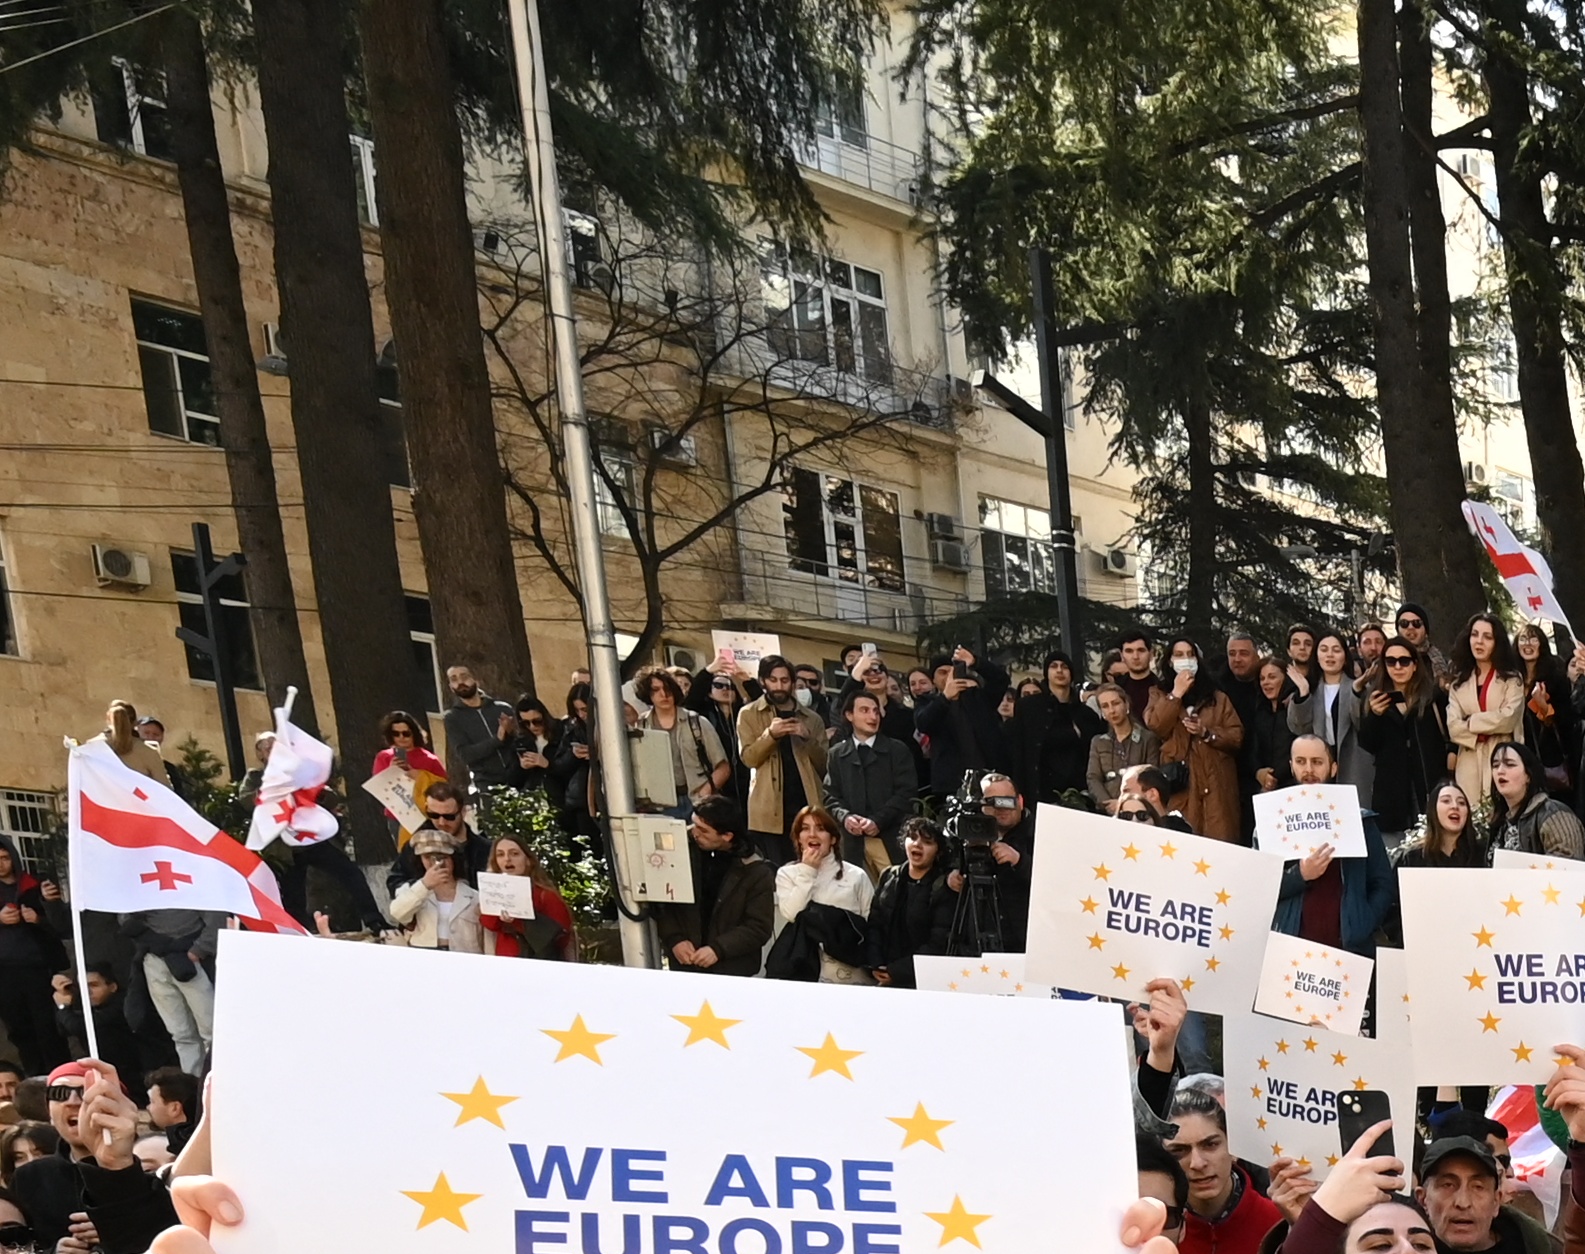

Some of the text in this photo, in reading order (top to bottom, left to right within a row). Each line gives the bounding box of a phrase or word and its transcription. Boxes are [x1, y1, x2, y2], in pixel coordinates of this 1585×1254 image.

[1285, 812, 1330, 823] WE ARE
[1286, 821, 1332, 832] EUROPE
[1108, 887, 1213, 927] WE ARE
[1106, 910, 1212, 948] EUROPE
[1494, 954, 1545, 977] WE
[1294, 981, 1340, 1001] EUROPE
[1297, 970, 1341, 991] WE ARE
[1267, 1077, 1338, 1112] WE AR
[1267, 1096, 1337, 1125] EUROP
[508, 1143, 897, 1213] WE ARE
